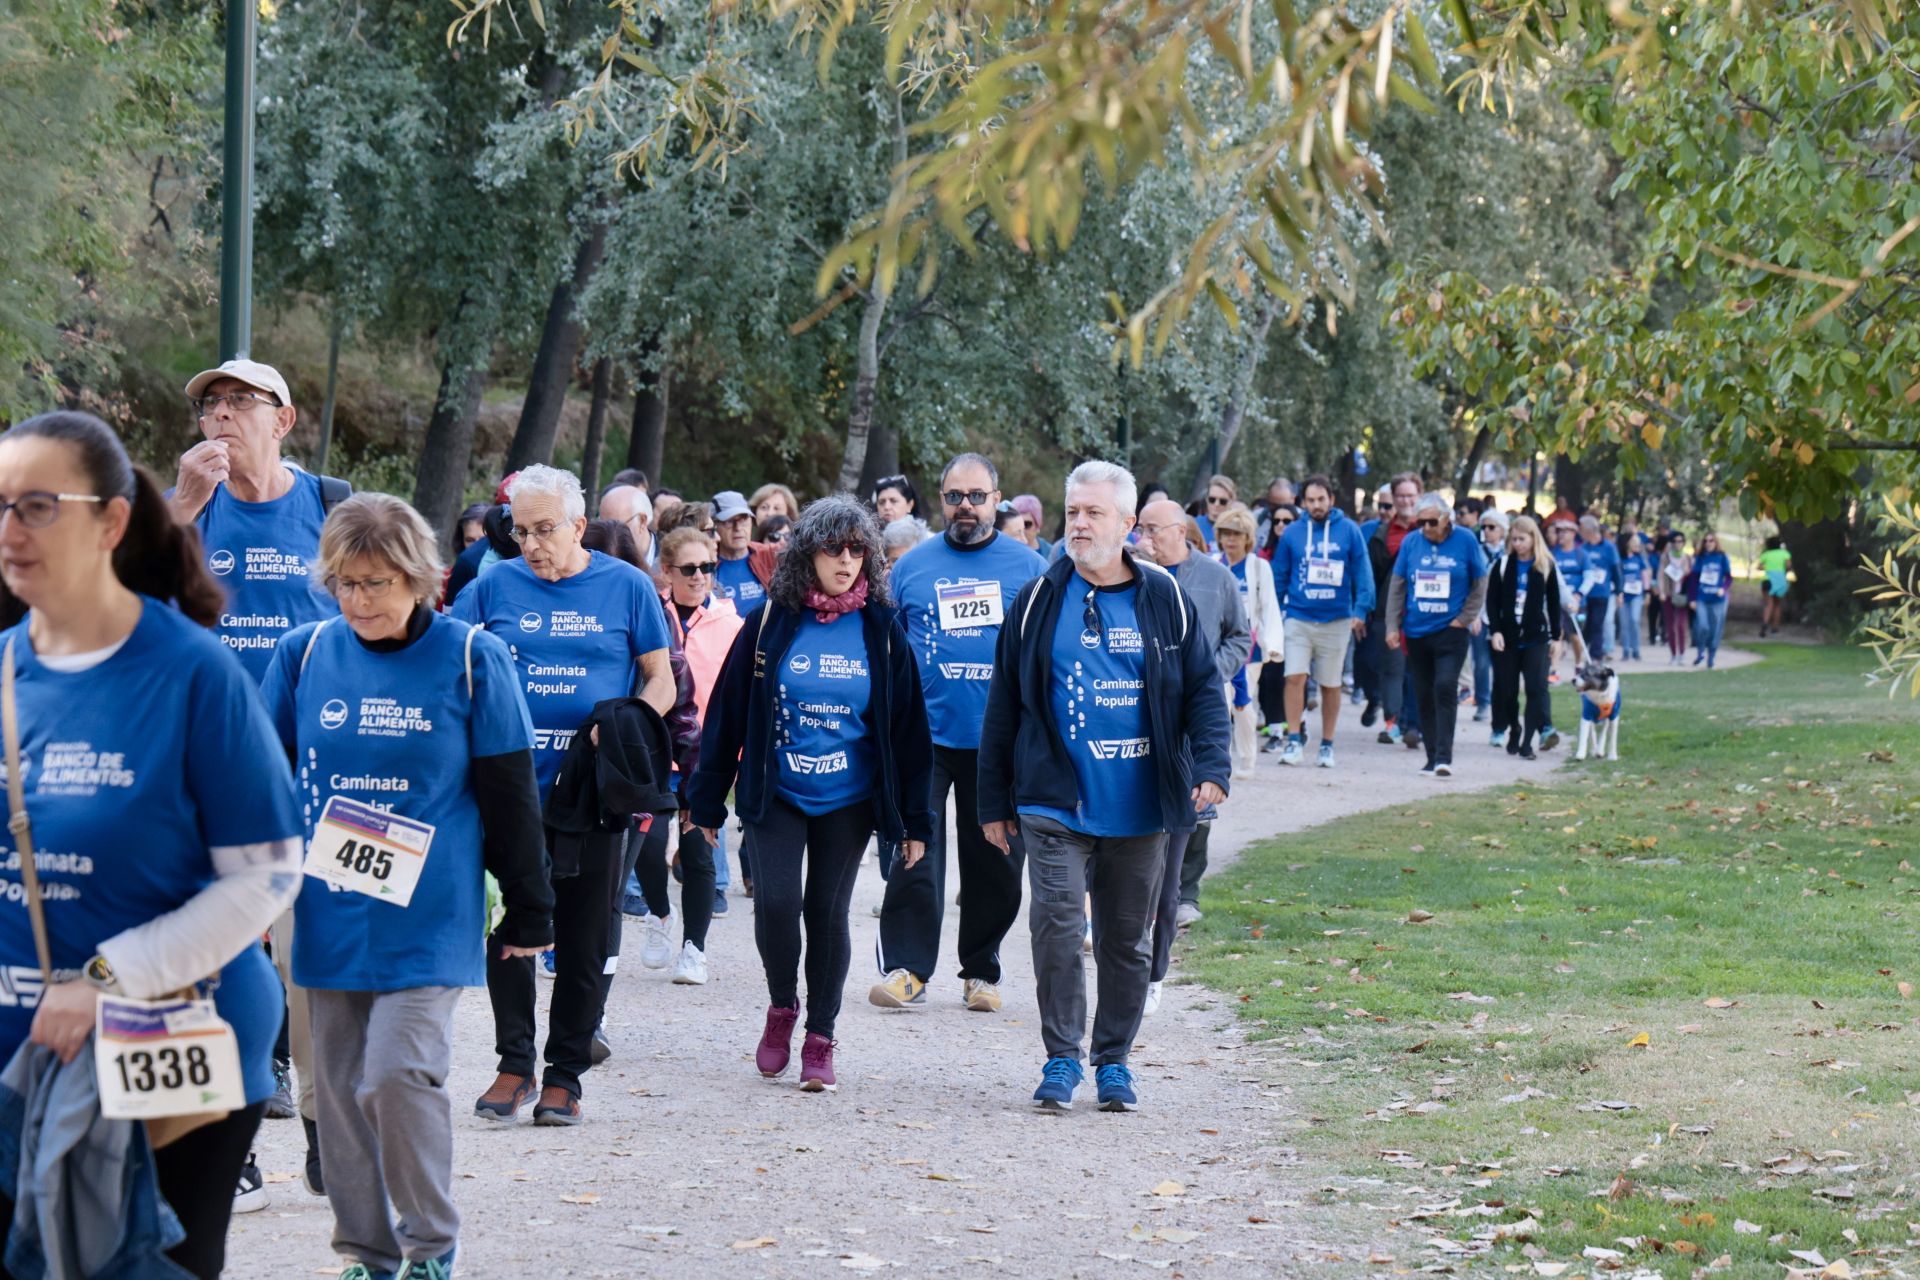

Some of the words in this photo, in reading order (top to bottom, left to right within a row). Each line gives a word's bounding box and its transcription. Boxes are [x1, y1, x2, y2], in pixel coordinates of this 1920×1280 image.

[246, 554, 282, 563] BANCO
[285, 555, 299, 565] DE
[246, 564, 307, 576] ALIMENTOS
[951, 600, 990, 619] 1225
[221, 613, 289, 628] Caminata
[551, 616, 582, 624] BANCO
[584, 616, 597, 624] DE
[551, 624, 603, 632] ALIMENTOS
[945, 628, 982, 639] Popular
[220, 635, 277, 652] Popular
[528, 663, 587, 677] Caminata
[820, 659, 849, 667] BANCO
[850, 660, 862, 668] DE
[819, 666, 867, 676] ALIMENTOS
[527, 681, 577, 696] Popular
[1093, 678, 1144, 690] Caminata
[798, 702, 851, 715] Caminata
[1095, 695, 1138, 709] Popular
[360, 704, 402, 717] BANCO
[405, 707, 423, 719] DE
[358, 716, 432, 731] ALIMENTOS
[800, 716, 840, 730] Popular
[1121, 743, 1150, 759] ULSA
[99, 752, 125, 769] DE
[815, 757, 848, 774] ULSA
[330, 774, 409, 791] Caminata
[335, 839, 395, 881] 485
[114, 1046, 211, 1092] 1338
